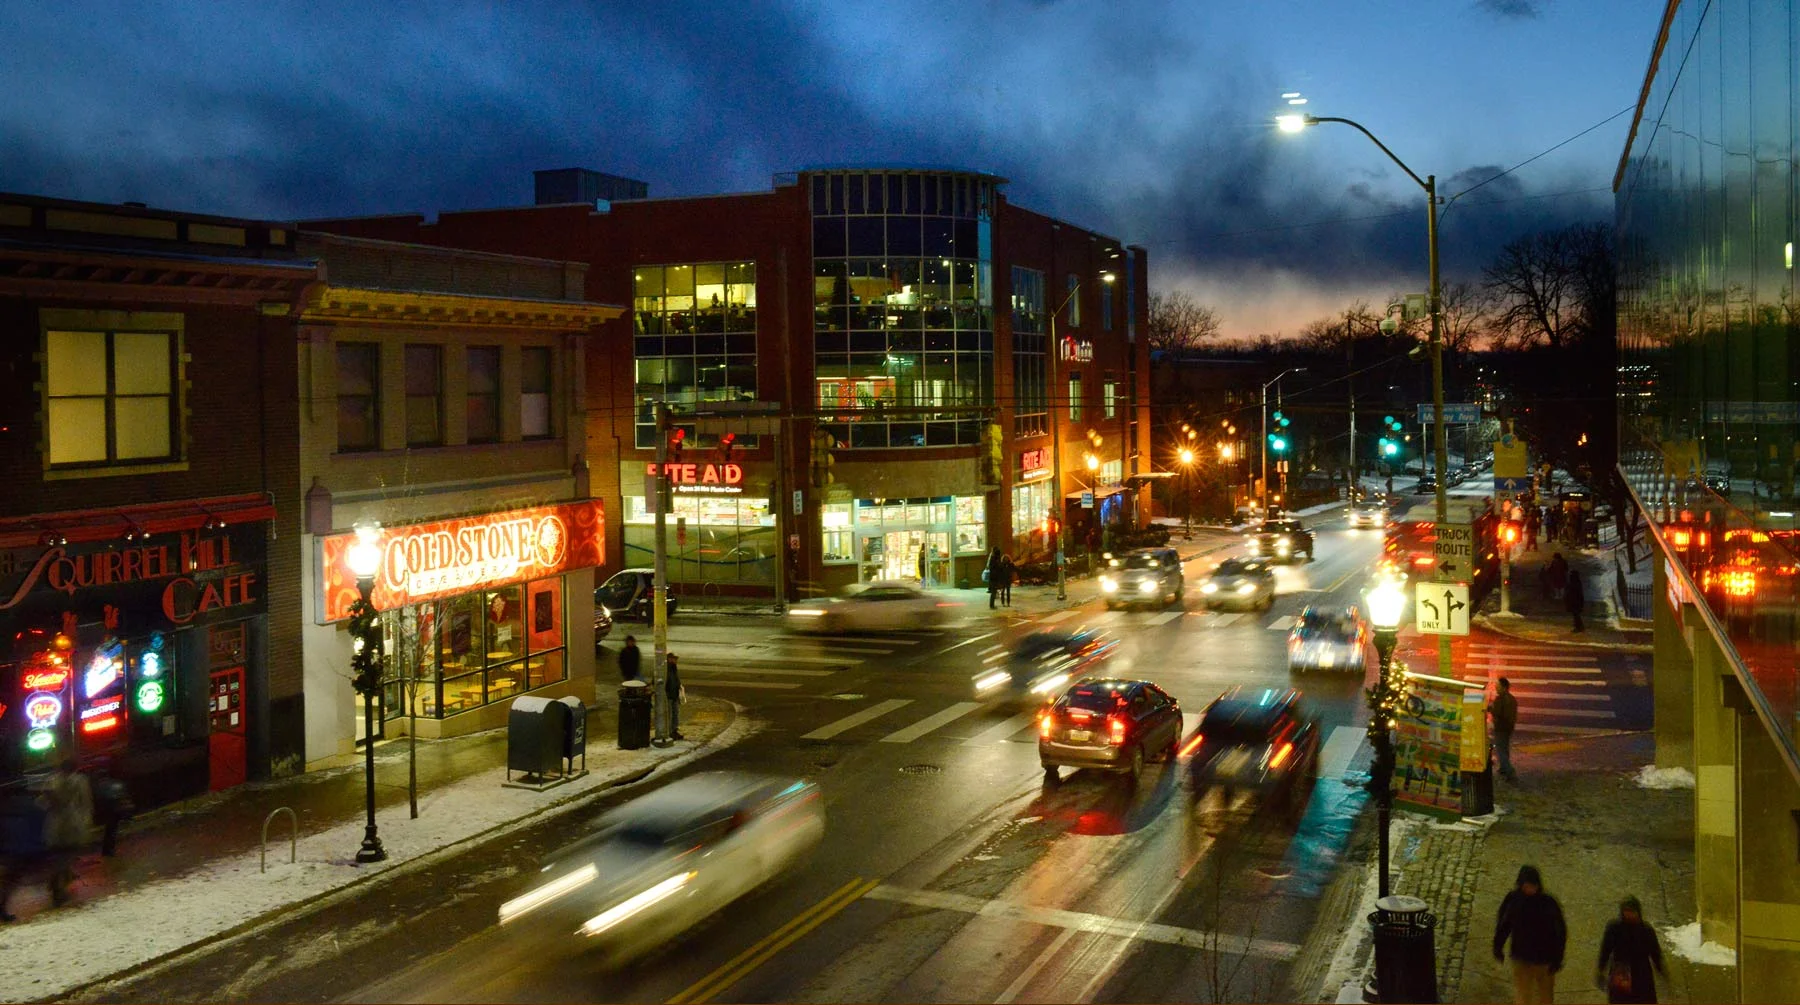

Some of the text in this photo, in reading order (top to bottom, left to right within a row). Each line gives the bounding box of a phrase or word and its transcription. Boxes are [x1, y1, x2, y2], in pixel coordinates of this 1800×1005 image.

[1436, 528, 1470, 541] TRUCK
[1436, 544, 1470, 556] ROUTE
[0, 546, 175, 610] SQUIRREL
[181, 531, 240, 575] HILL
[386, 521, 533, 589] COLD STONE
[162, 573, 256, 623] CAFE
[1422, 620, 1440, 630] ONLY
